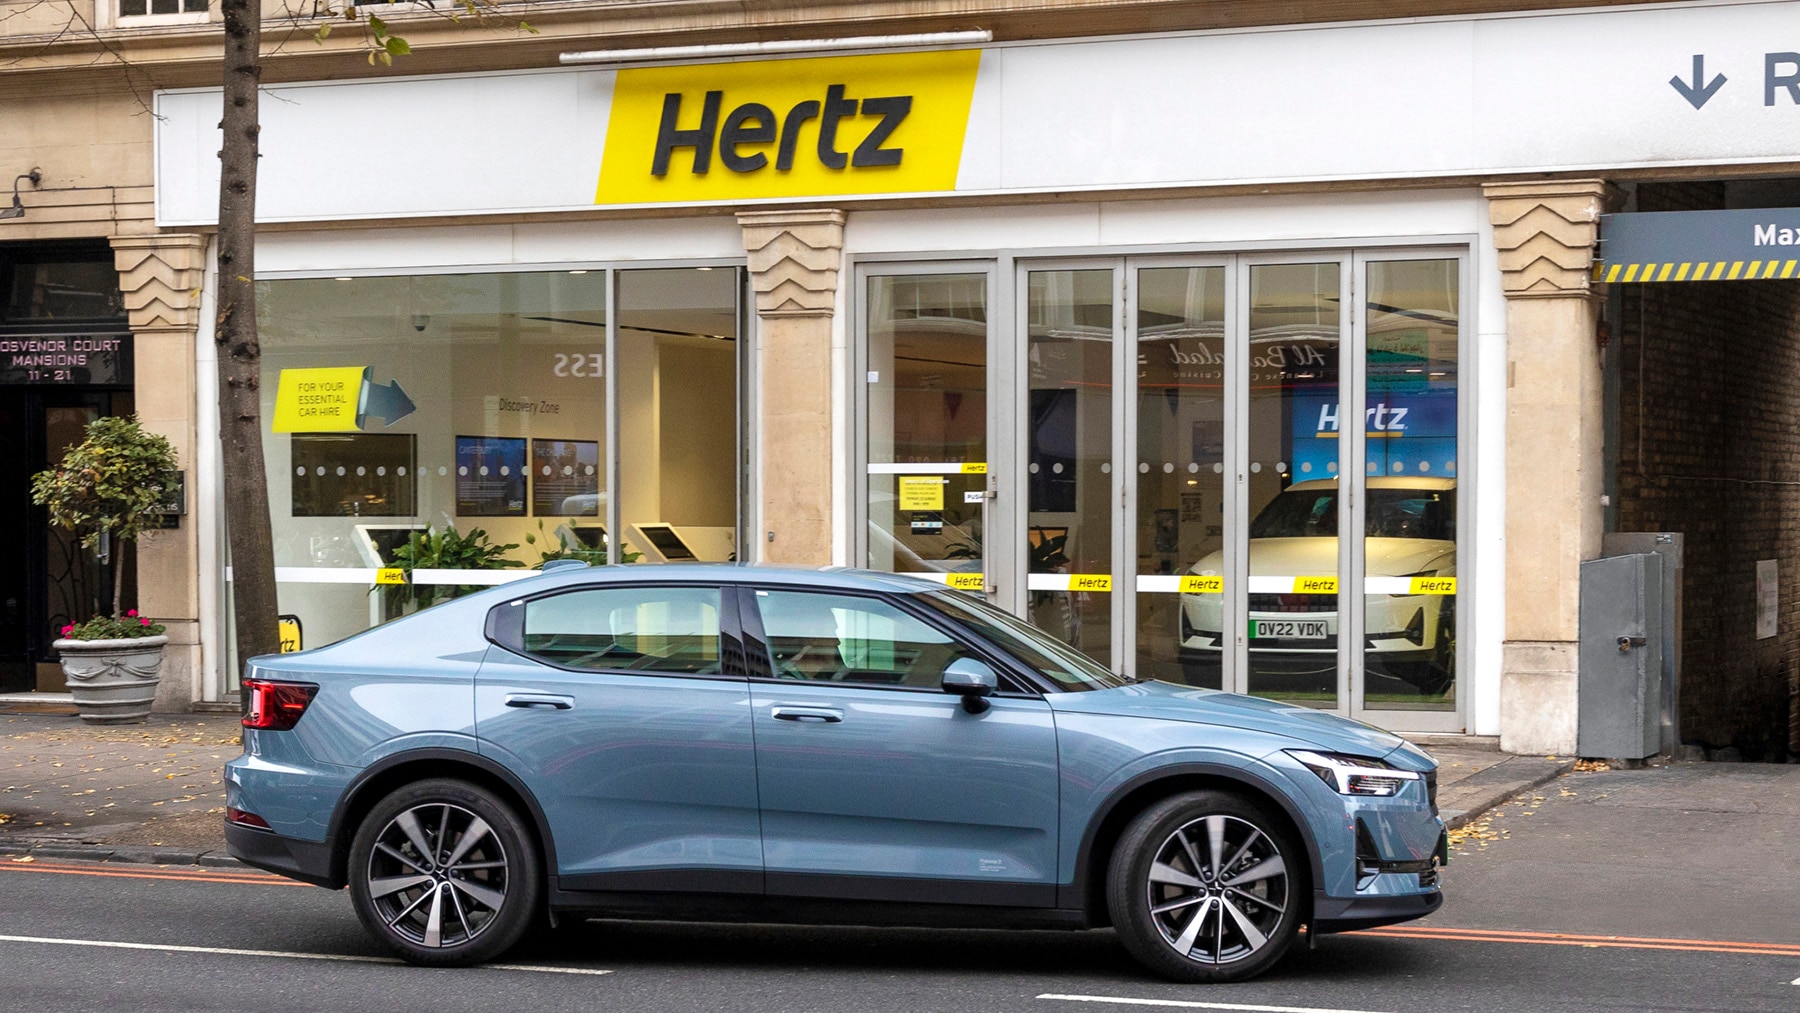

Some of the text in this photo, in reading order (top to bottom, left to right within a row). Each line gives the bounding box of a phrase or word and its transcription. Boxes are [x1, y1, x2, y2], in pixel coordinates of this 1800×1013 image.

[1764, 52, 1800, 106] R
[651, 84, 913, 176] Hertz
[0, 340, 121, 352] OSVENOR COURT
[12, 355, 87, 366] MANSIONS
[28, 370, 40, 380] 11
[54, 370, 72, 380] 21
[298, 382, 344, 392] FOR YOUR
[298, 394, 347, 405] ESSENTIAL
[299, 406, 341, 417] CAR HIRE
[499, 398, 560, 415] Discovery Zone
[1317, 403, 1408, 430] Hrtz
[955, 576, 983, 587] Hertz
[1078, 577, 1108, 588] Hertz
[1189, 579, 1219, 590] Hertz
[1303, 580, 1335, 590] Hertz
[1420, 580, 1452, 591] Hertz
[1258, 623, 1324, 636] OV22 VDK
